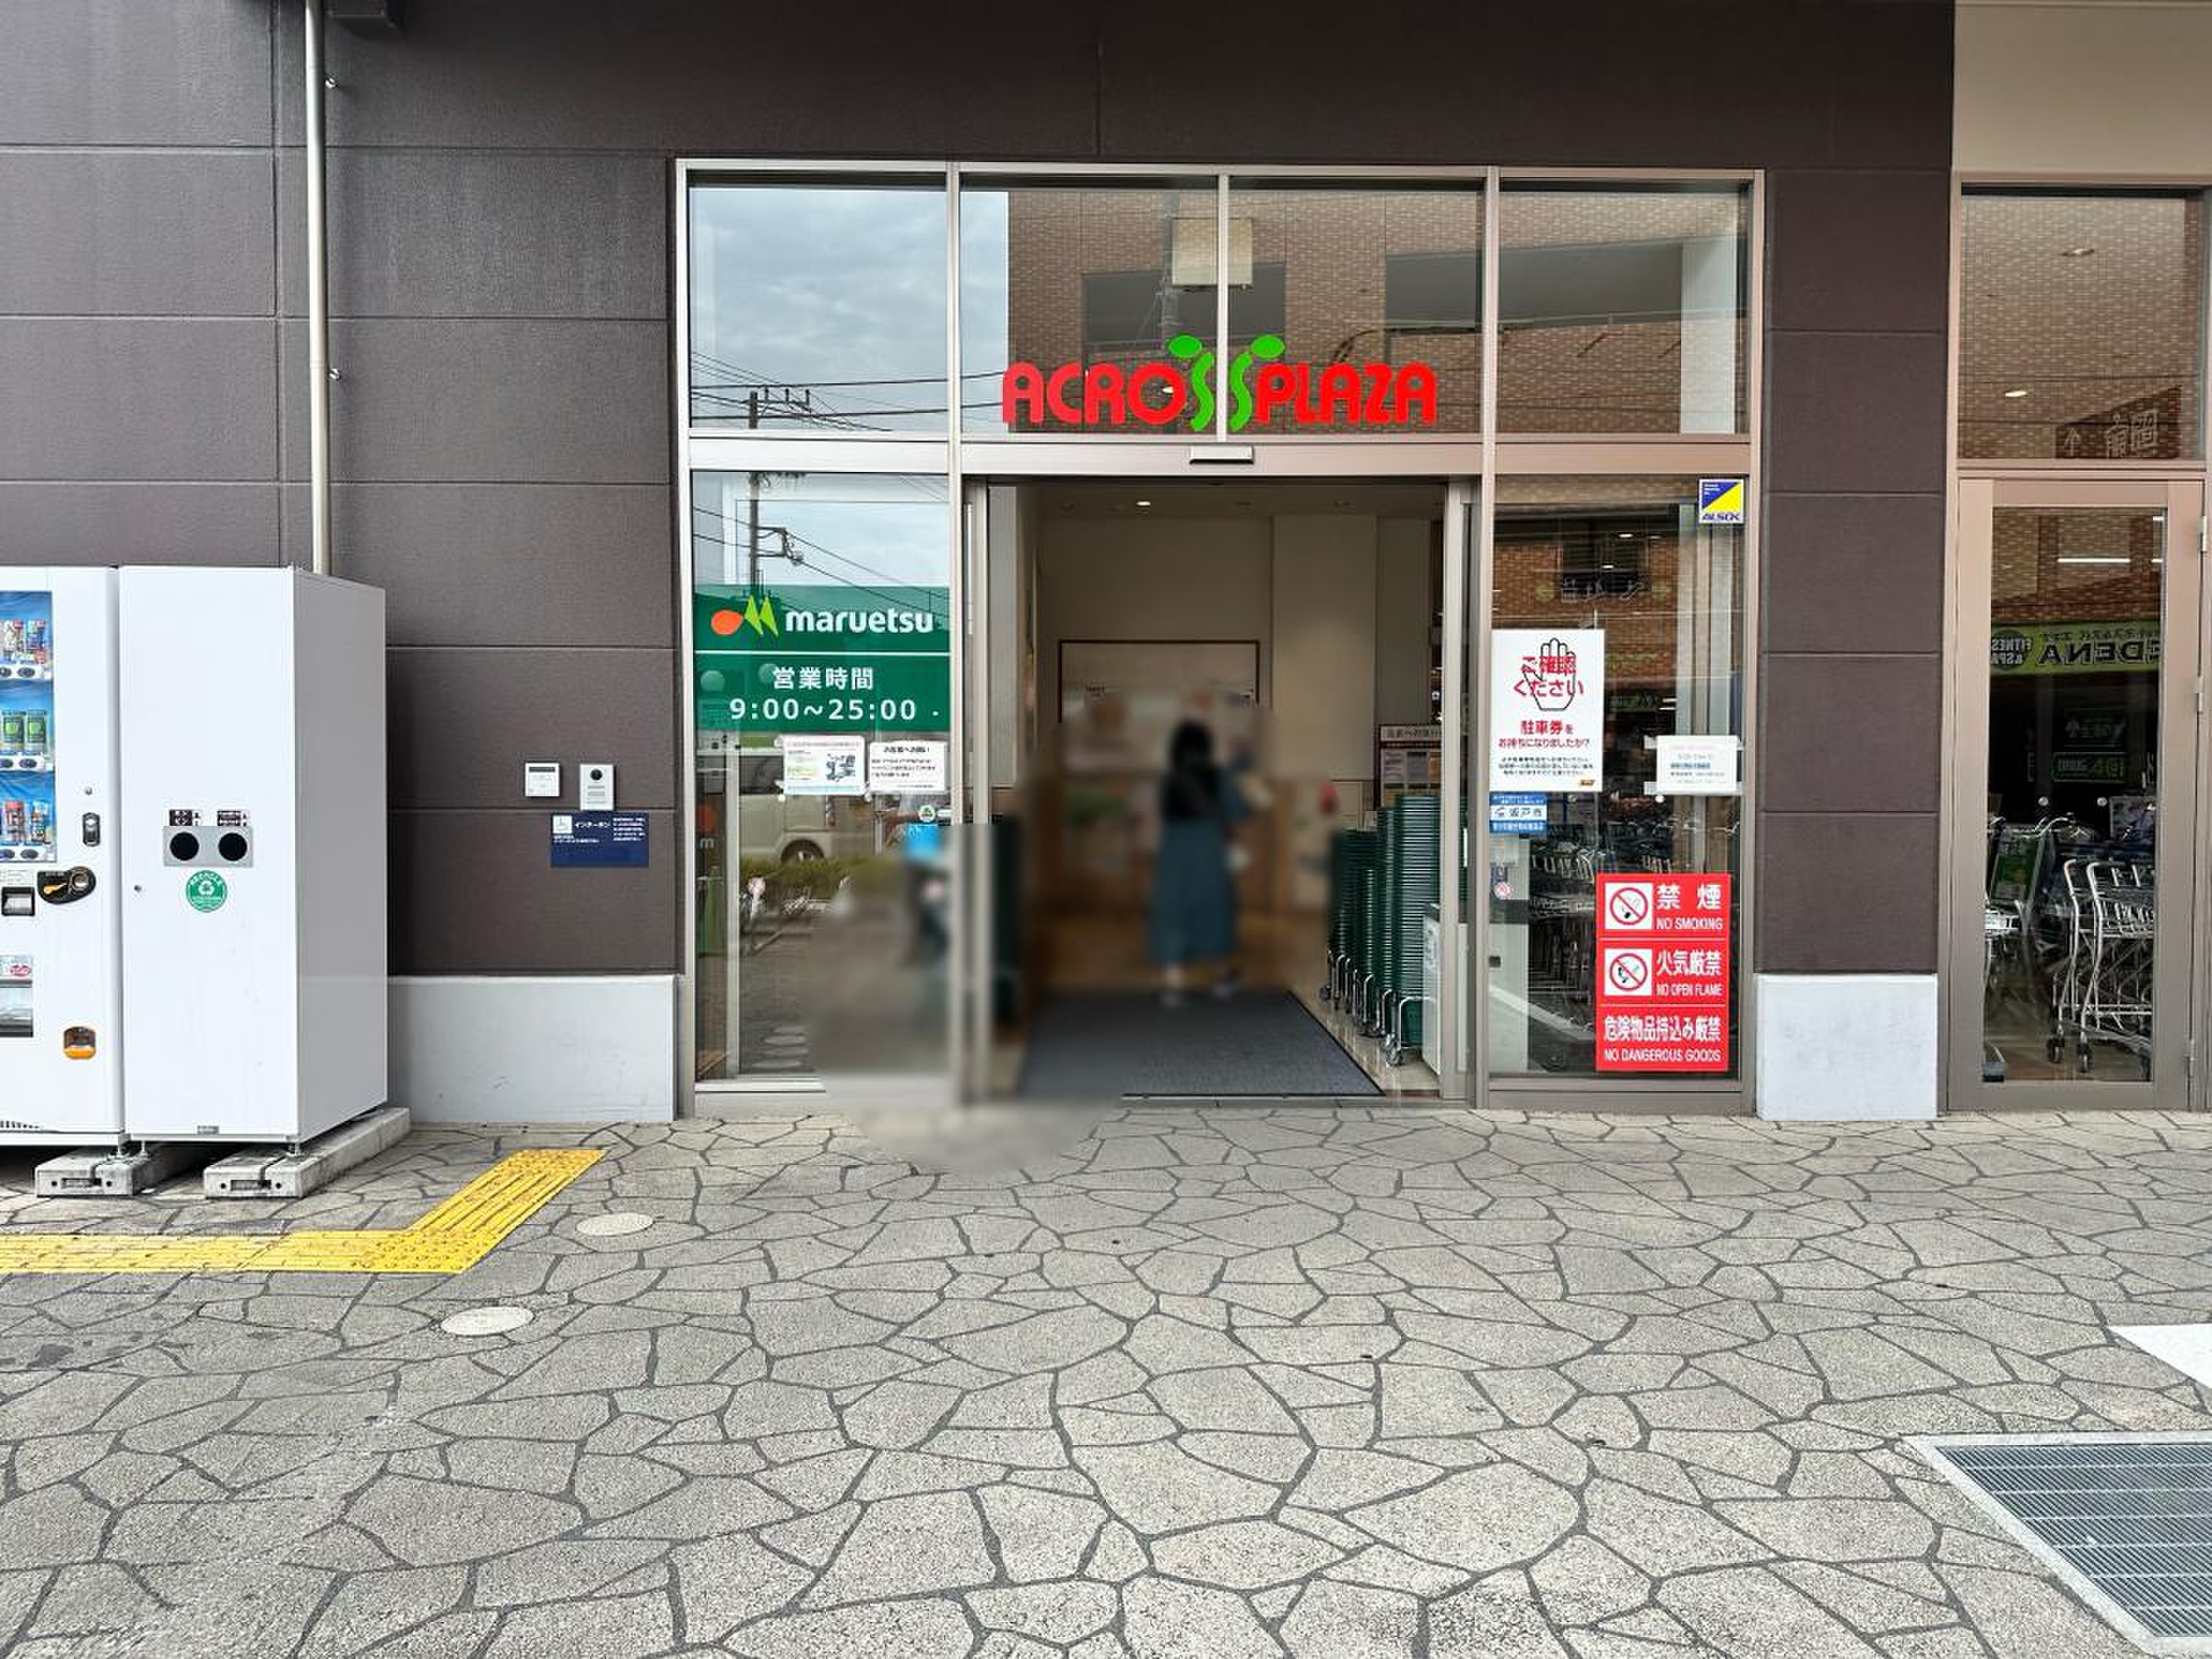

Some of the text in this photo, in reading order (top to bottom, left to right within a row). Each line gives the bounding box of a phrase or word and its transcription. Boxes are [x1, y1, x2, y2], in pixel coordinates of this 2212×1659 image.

[1003, 335, 1438, 431] ACROSS PLAZA
[785, 608, 935, 633] maruetsu
[1521, 655, 1576, 675] ご確認
[772, 666, 874, 689] 営業時間
[1513, 679, 1583, 697] ください
[1521, 720, 1573, 735] 駐車券を
[1656, 917, 1723, 930] NO SMOKING
[1656, 949, 1722, 976] 火気厳禁
[1656, 983, 1723, 995] NO OPEN FLAME
[1604, 1049, 1721, 1062] NO DANGEROUS GOODS
